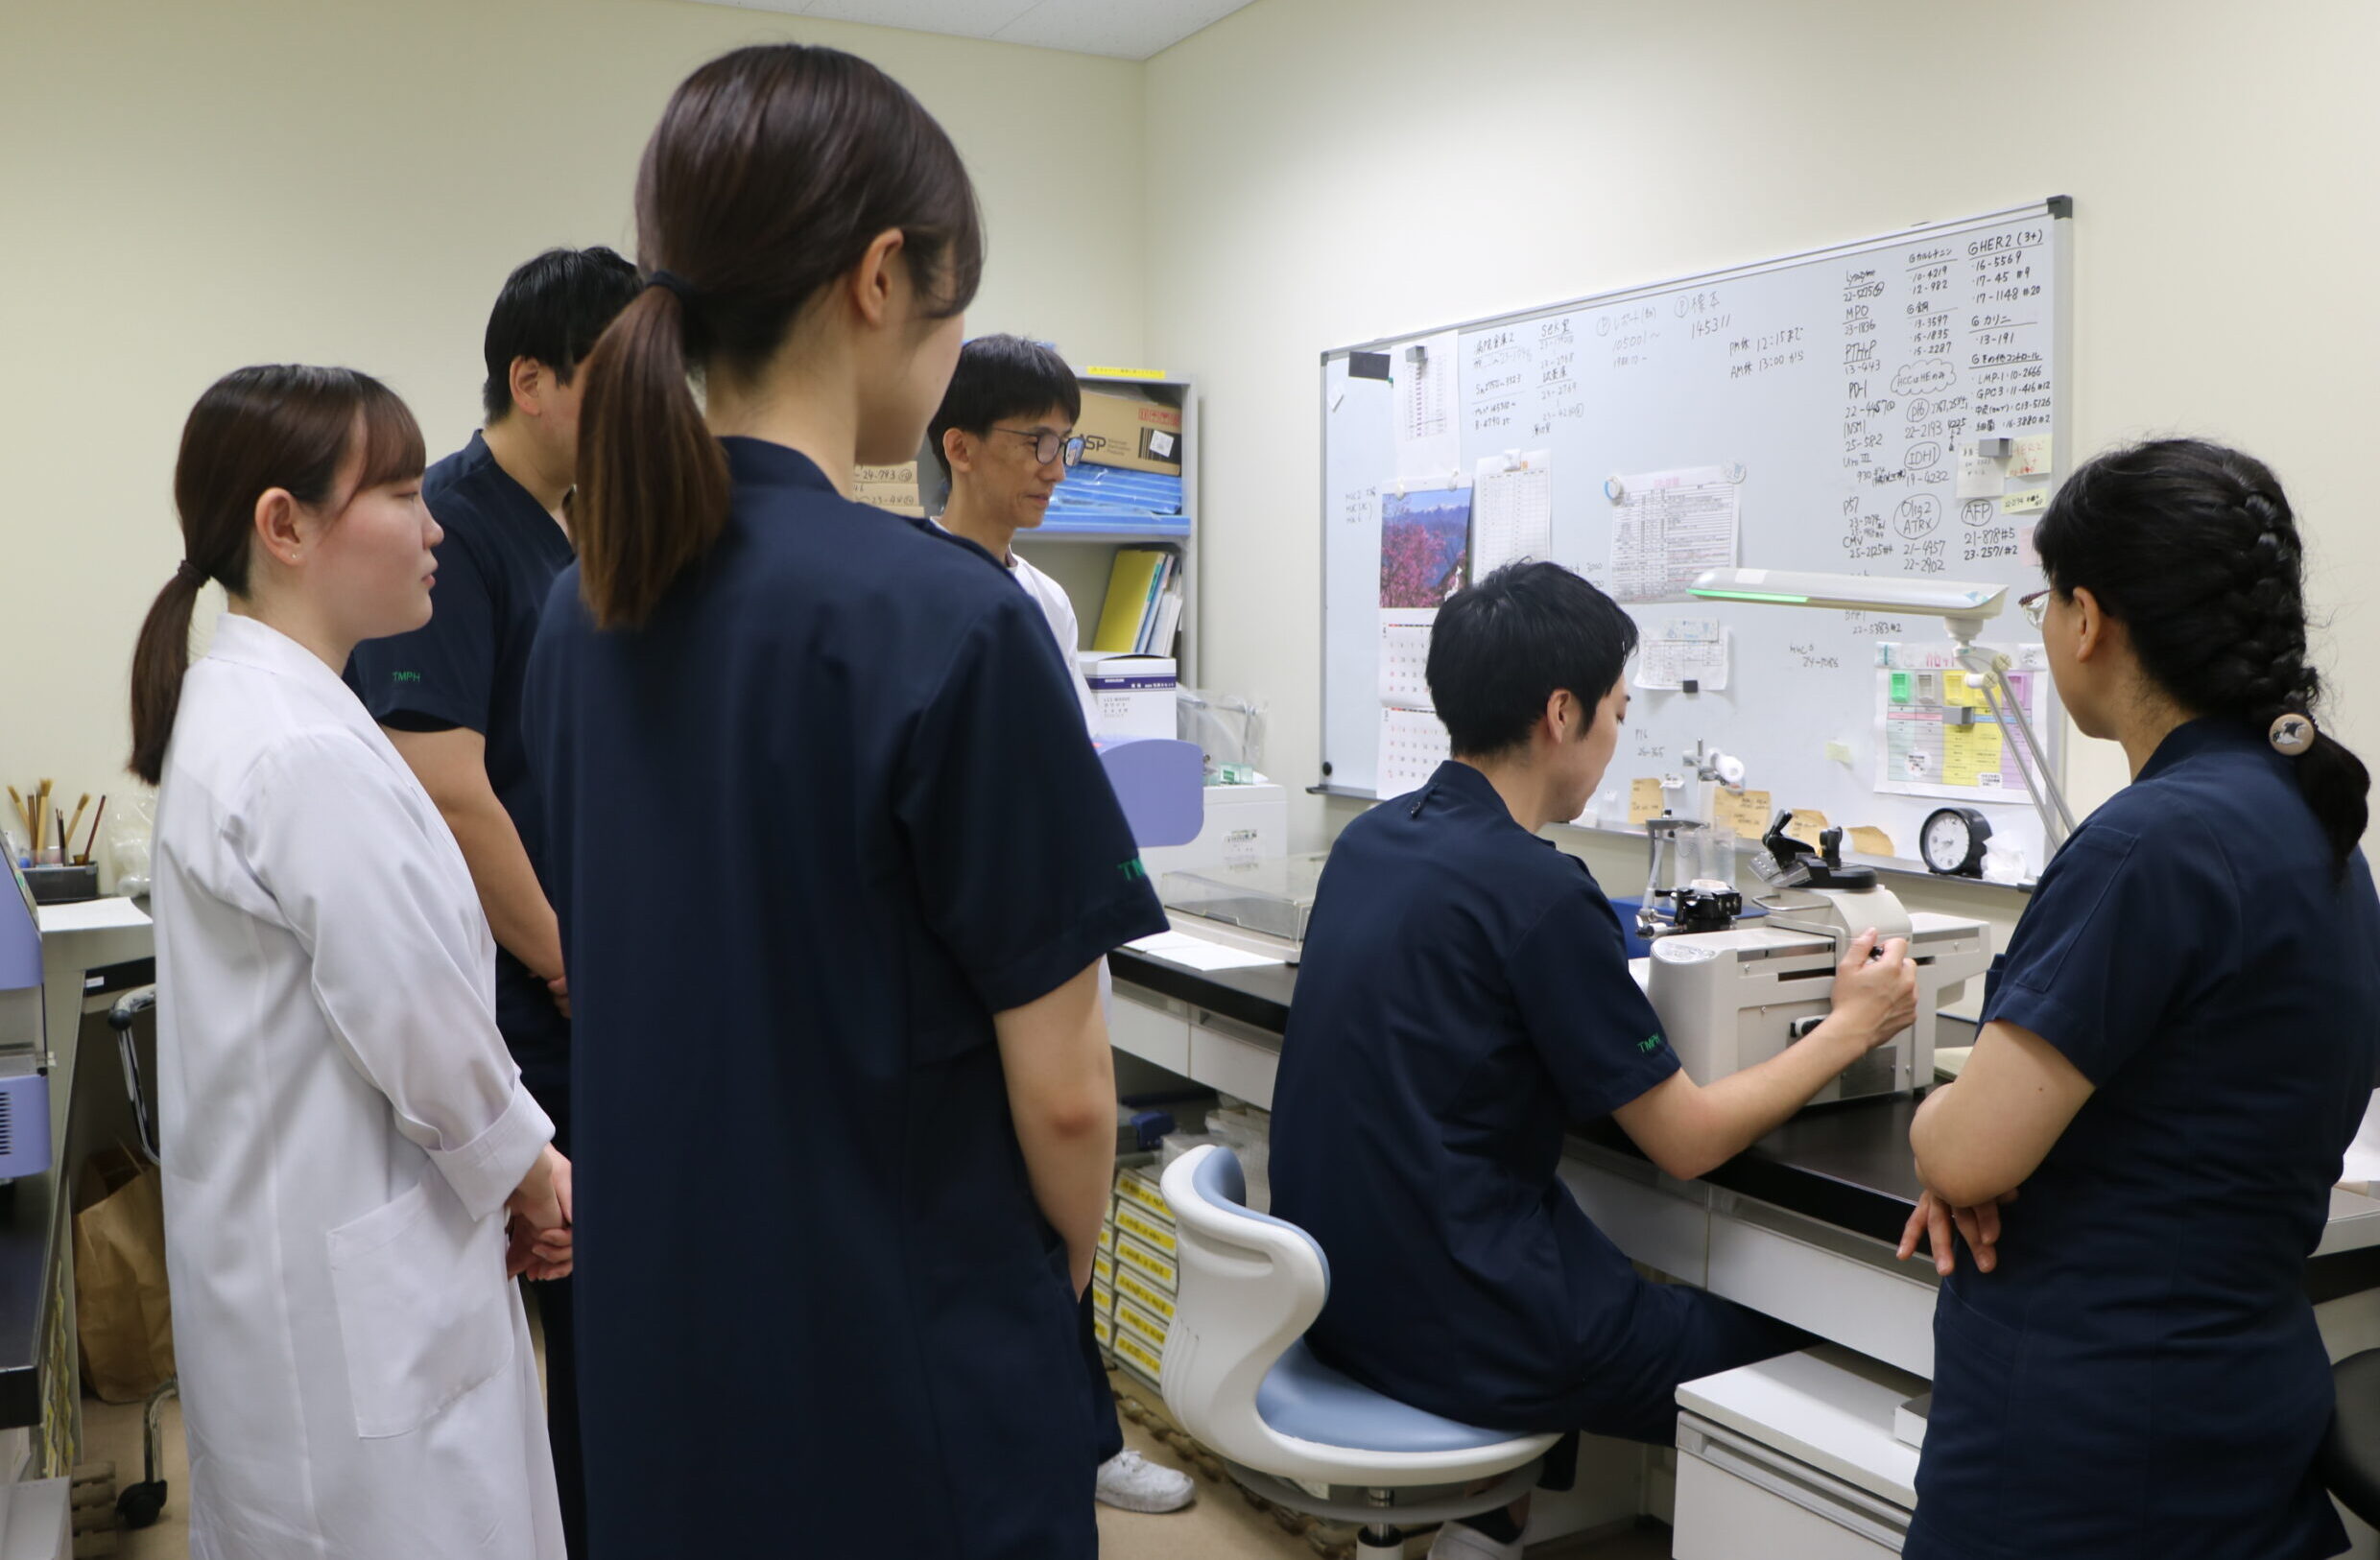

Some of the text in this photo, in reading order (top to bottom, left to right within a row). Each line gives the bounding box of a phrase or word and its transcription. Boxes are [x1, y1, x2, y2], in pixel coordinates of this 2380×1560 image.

[2016, 229, 2043, 247] (3+)
[1976, 250, 2022, 272] 16-5569
[1976, 287, 2019, 304] 17-1148
[1845, 305, 1869, 319] MPO
[1079, 435, 1107, 452] SP
[1965, 504, 1989, 520] AFP
[1843, 536, 1863, 548] CMV
[393, 672, 420, 683] TMPH
